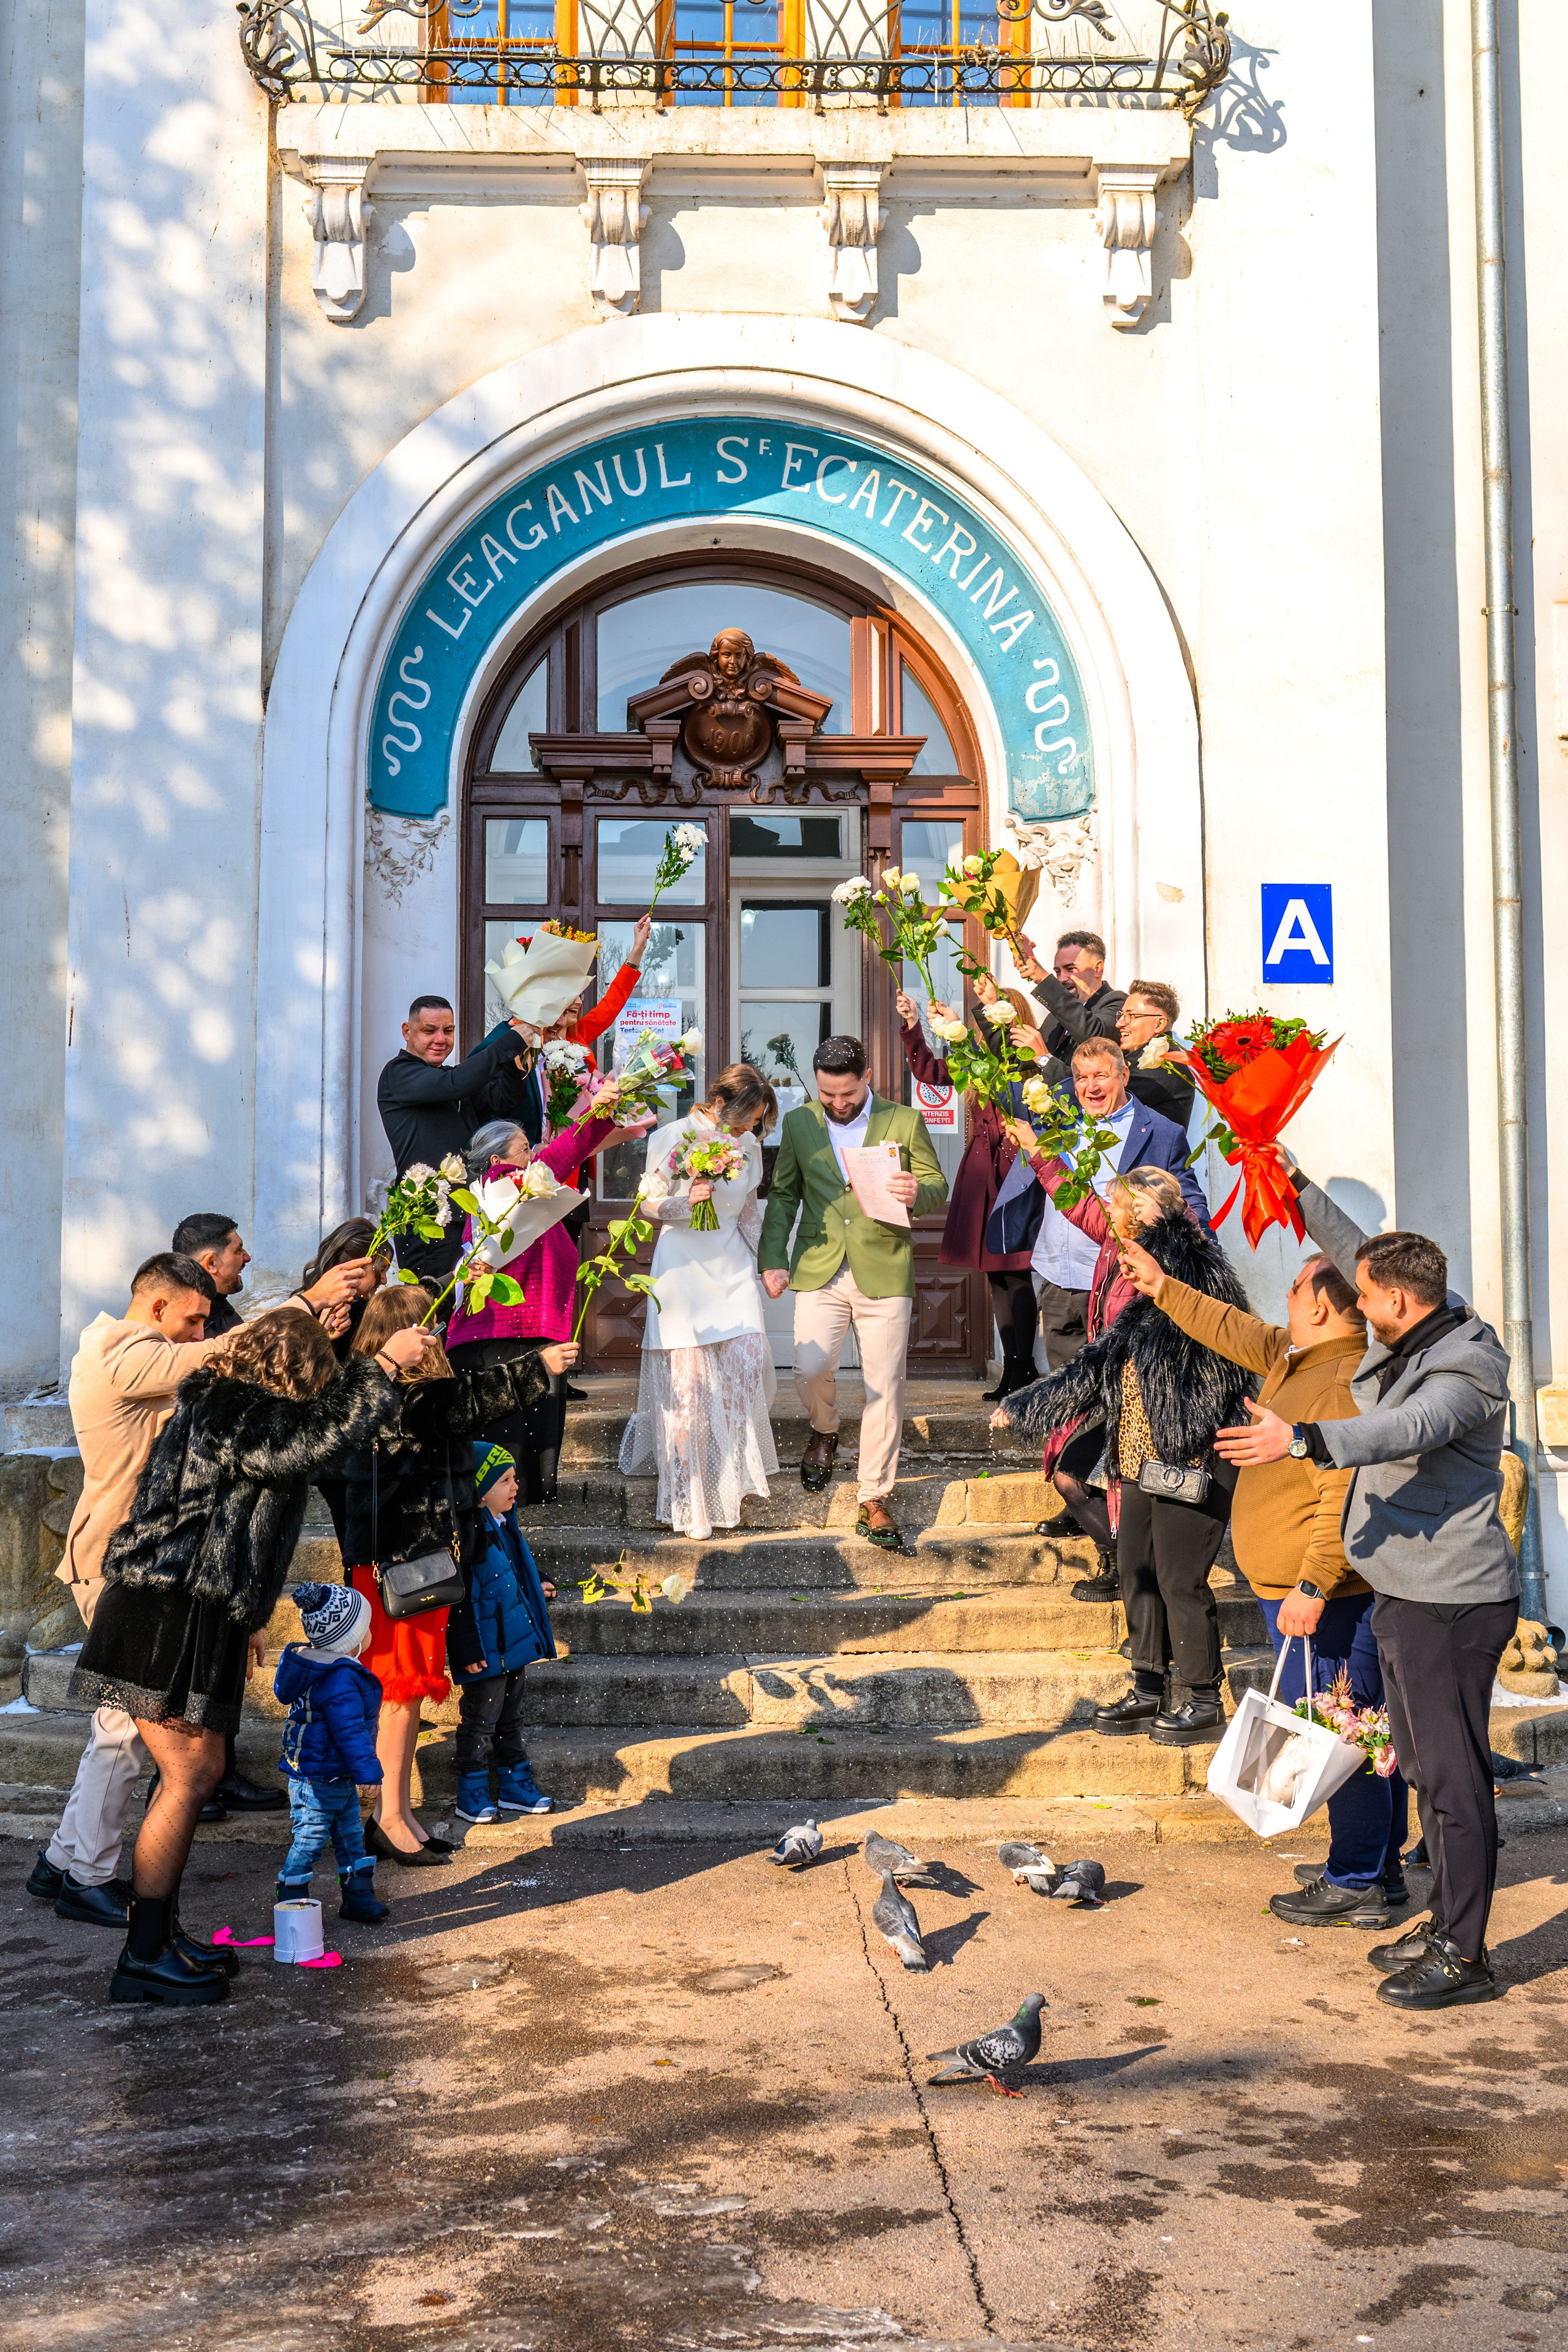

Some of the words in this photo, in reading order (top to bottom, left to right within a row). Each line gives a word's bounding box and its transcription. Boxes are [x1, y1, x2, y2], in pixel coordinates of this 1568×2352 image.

[426, 444, 692, 640] LEAGANUL
[781, 442, 1035, 653] ECATERINA
[1265, 899, 1330, 965] A
[649, 1010, 670, 1019] timp
